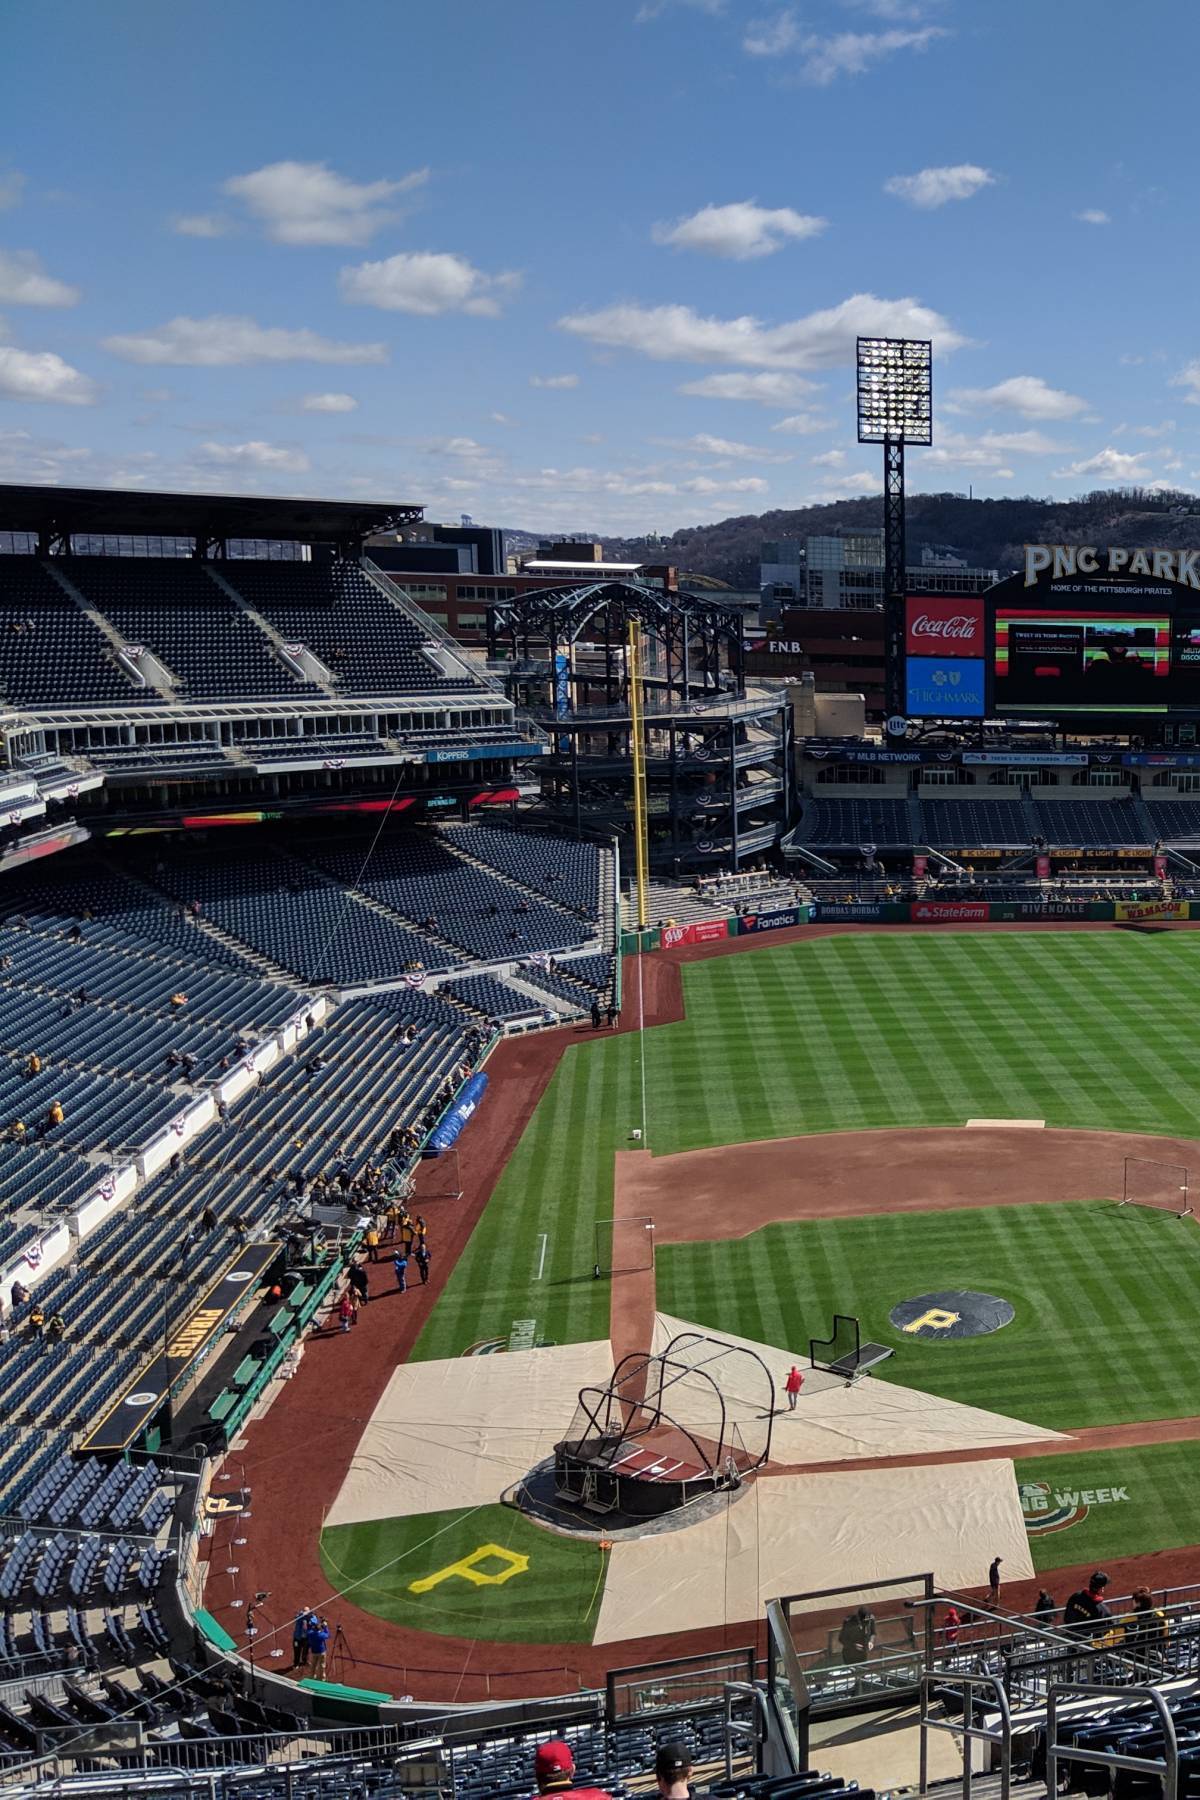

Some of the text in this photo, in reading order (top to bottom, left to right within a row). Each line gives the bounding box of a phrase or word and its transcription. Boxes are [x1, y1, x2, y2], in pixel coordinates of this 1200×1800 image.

[1024, 543, 1099, 588] PNC
[1050, 584, 1071, 592] HOME
[1072, 585, 1083, 593] OF
[1098, 586, 1142, 594] PITTSBURGH
[911, 614, 980, 639] Coca-Cola
[769, 641, 804, 654] F.N.B.
[889, 721, 906, 730] Lite
[437, 751, 469, 761] KOPPERS
[857, 752, 921, 762] MLB NETWORK
[1021, 904, 1085, 913] RIVENDALE
[757, 914, 795, 930] Fanatics
[902, 1308, 962, 1333] P
[166, 1308, 224, 1359] PIRATES
[1054, 1486, 1131, 1507] WEEK
[407, 1540, 530, 1594] P
